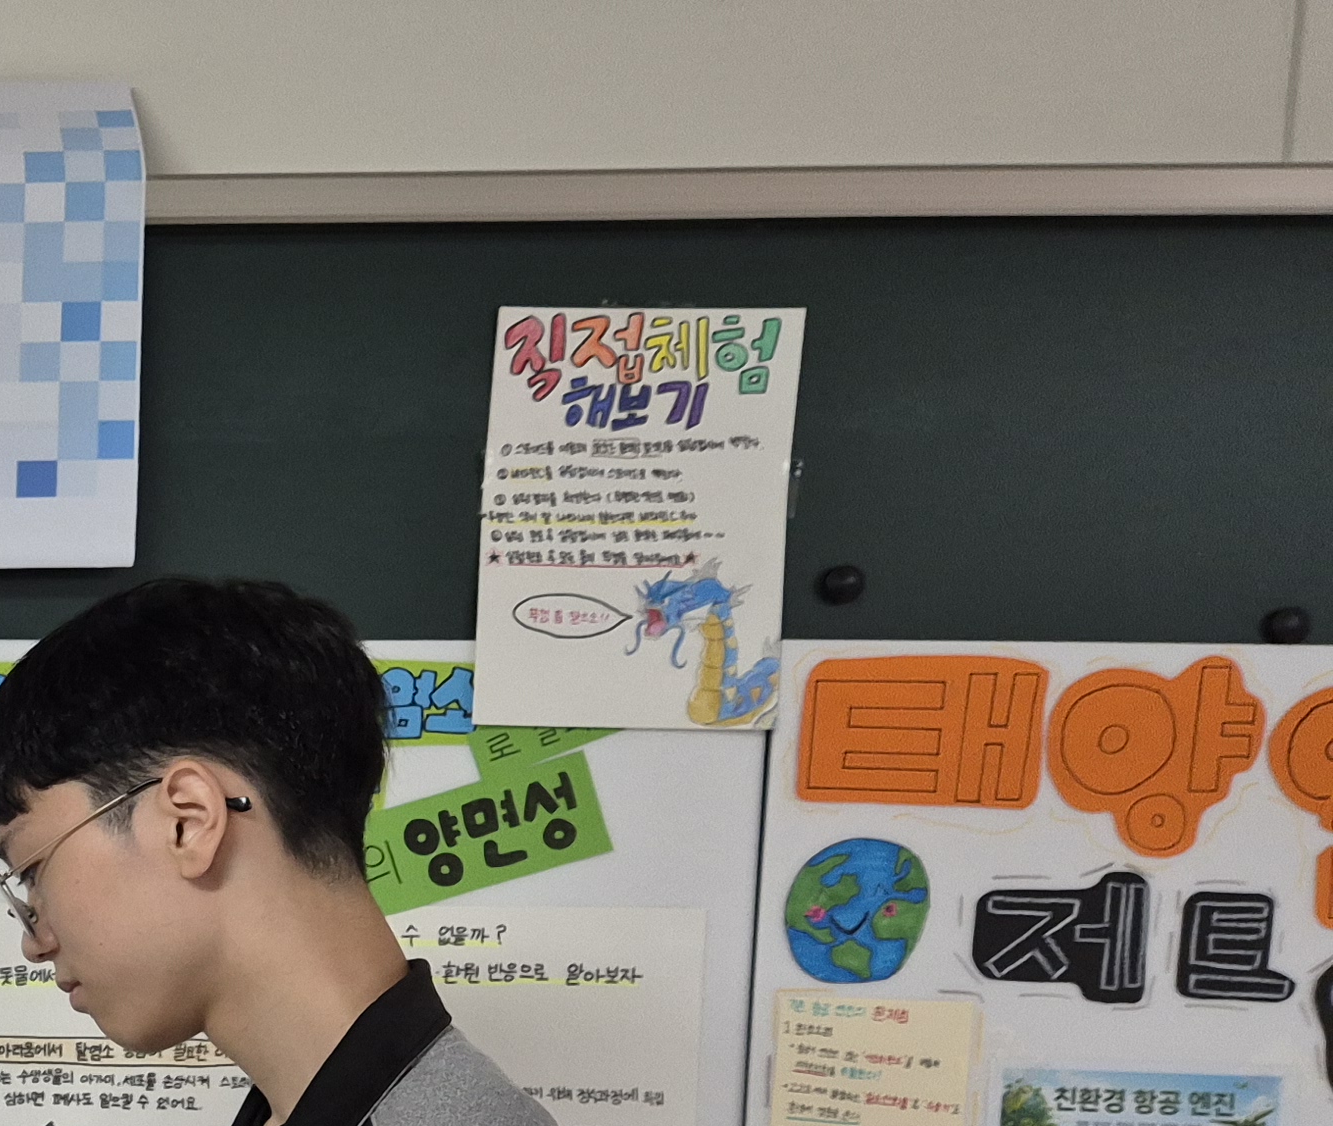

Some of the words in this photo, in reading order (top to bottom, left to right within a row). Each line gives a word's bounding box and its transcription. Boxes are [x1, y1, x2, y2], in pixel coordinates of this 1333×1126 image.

[504, 312, 783, 401] 직접체험
[562, 376, 710, 431] 해보기
[403, 771, 578, 887] 양면성
[973, 872, 1295, 1002] 제트
[1053, 1086, 1126, 1114] 친환경
[1132, 1089, 1182, 1116] 항공
[1188, 1090, 1237, 1118] 엔진
